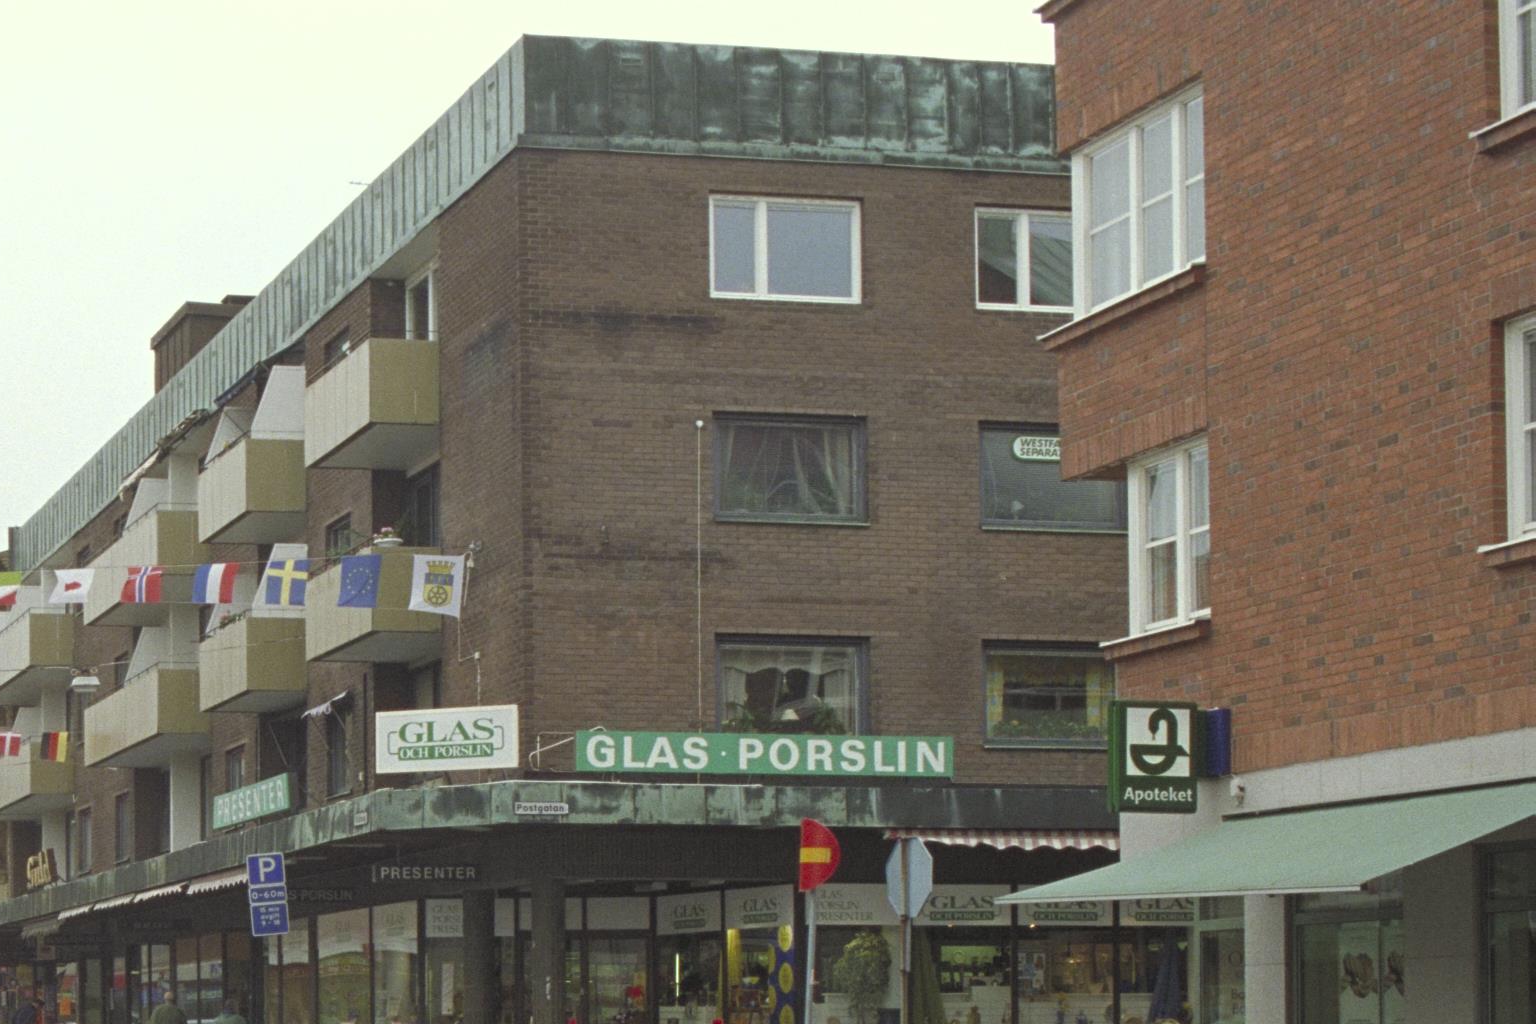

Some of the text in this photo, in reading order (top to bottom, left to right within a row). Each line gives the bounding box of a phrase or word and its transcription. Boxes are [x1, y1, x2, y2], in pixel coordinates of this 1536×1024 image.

[398, 717, 495, 744] GLAS
[400, 744, 492, 759] OCH PORSLIN
[585, 736, 709, 770] GLAS
[738, 738, 946, 773] PORSLIN
[1124, 786, 1193, 805] Apoteket
[516, 803, 565, 814] Postgatan
[258, 857, 276, 882] P
[380, 866, 476, 880] PRESENTER
[742, 898, 779, 913] GLAS
[929, 895, 995, 909] GLAS
